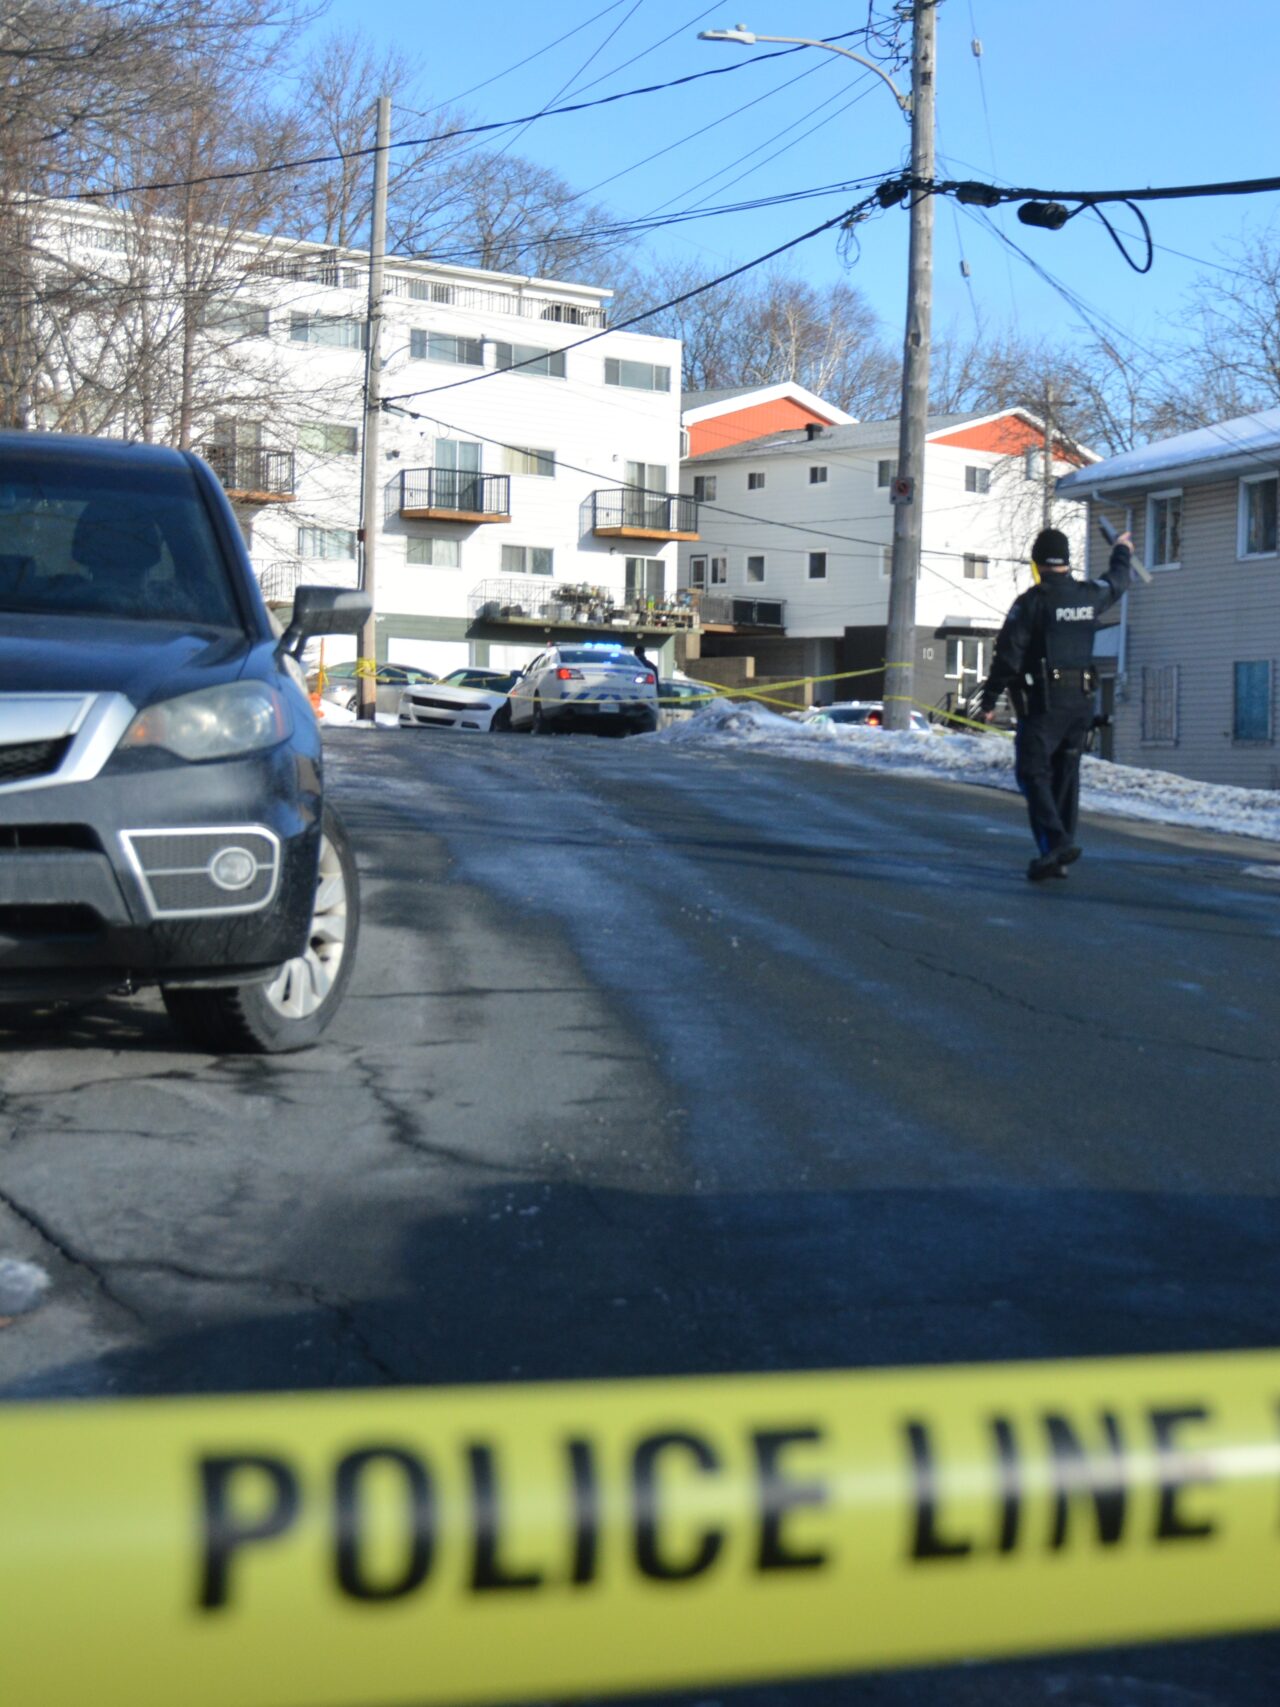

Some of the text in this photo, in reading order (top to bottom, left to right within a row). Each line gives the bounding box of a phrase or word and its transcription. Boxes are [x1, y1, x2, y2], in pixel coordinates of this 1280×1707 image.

[1055, 606, 1095, 621] POLICE
[195, 1425, 832, 1613] POLICE
[903, 1402, 1218, 1560] LINE
